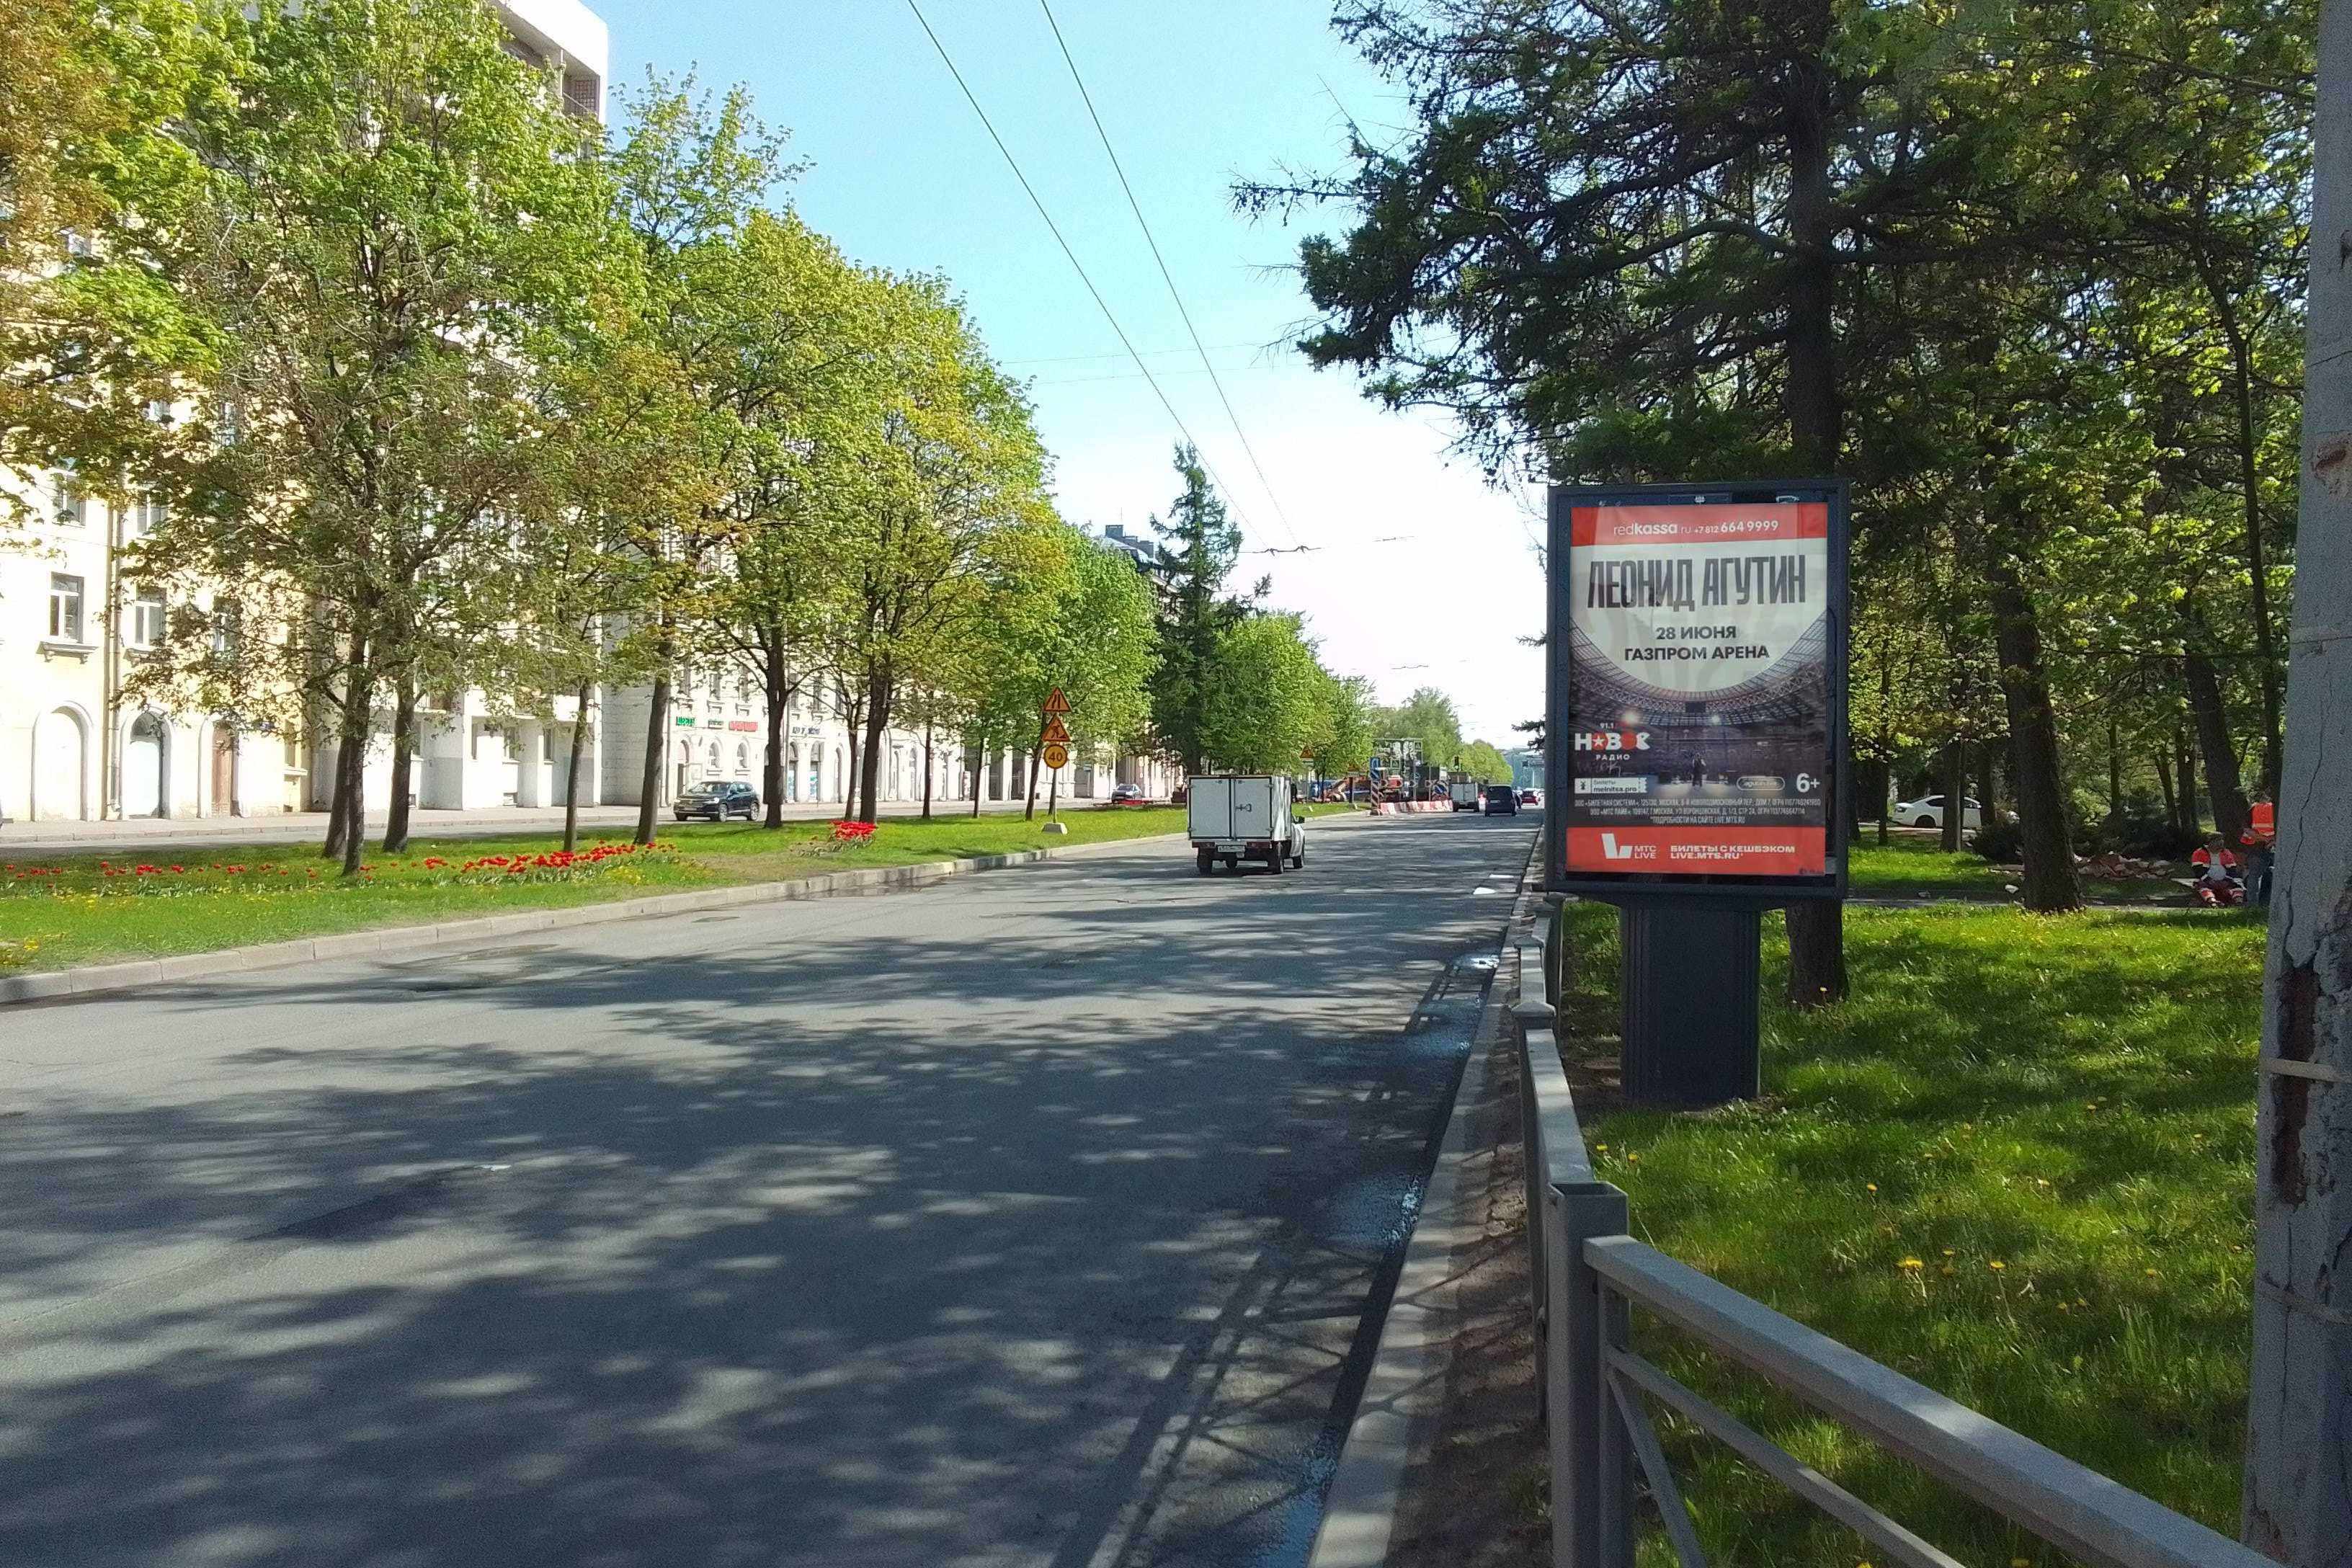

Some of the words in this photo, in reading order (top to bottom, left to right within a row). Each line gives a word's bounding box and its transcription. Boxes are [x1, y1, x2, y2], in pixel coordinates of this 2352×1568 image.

[1721, 522, 1745, 533] 664
[1747, 520, 1779, 532] 9999
[1587, 558, 1696, 612] ЛЕОНИД
[1701, 554, 1806, 606] АГУТИН
[1656, 627, 1676, 640] 28
[1680, 625, 1737, 640] ИЮНЯ
[1624, 647, 1708, 661] ГАЗПРОМ
[1711, 646, 1770, 660] АРЕНА
[1048, 752, 1063, 762] 40
[1796, 772, 1821, 793] 6+
